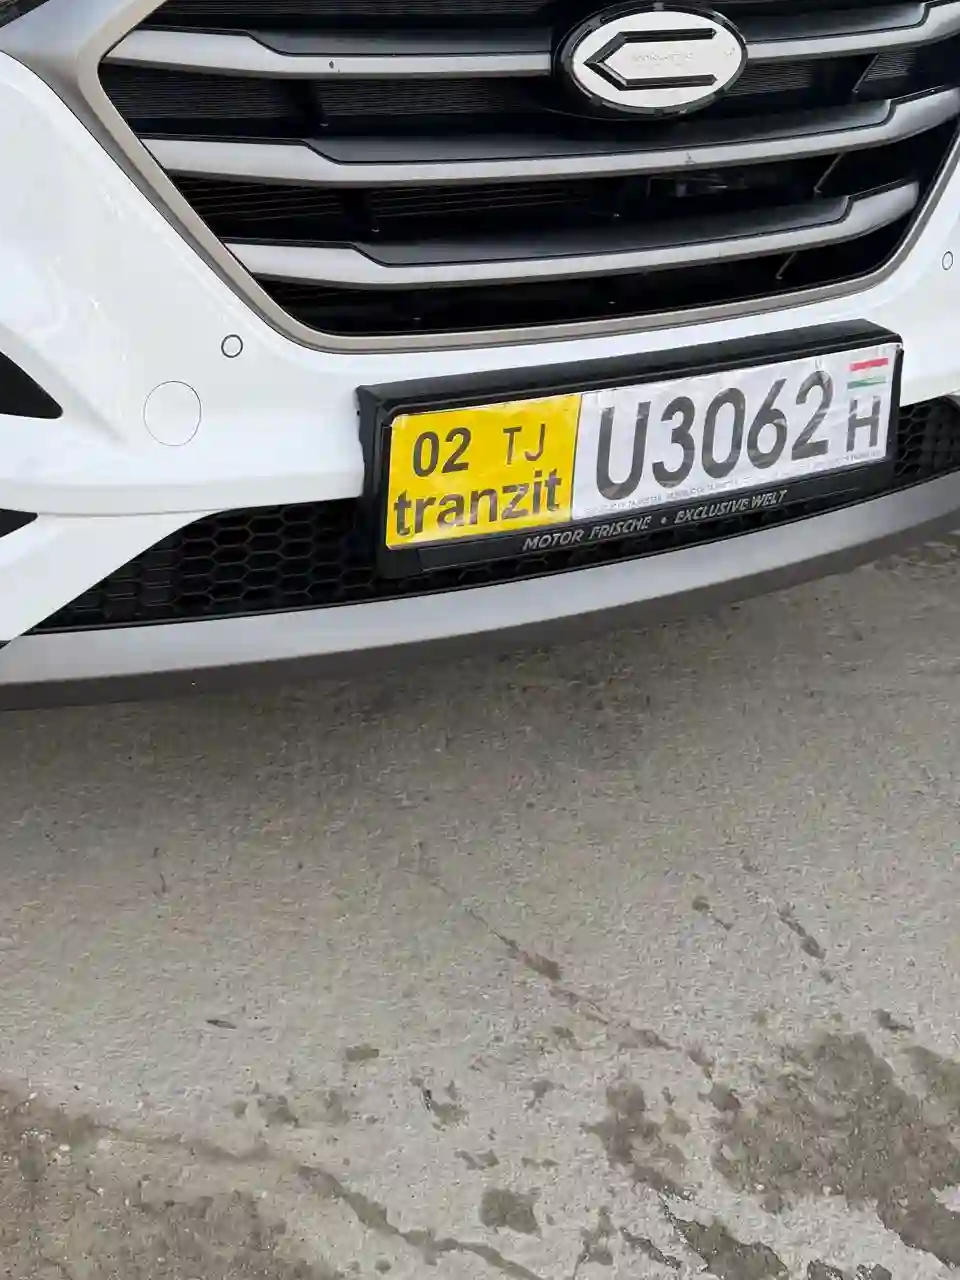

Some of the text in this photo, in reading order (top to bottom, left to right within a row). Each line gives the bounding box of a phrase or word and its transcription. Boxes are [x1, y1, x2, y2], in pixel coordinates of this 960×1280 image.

[413, 423, 546, 477] 02 TJ
[596, 370, 881, 501] U3062 H
[393, 468, 562, 537] tranzit
[521, 529, 585, 552] MOTOR
[674, 498, 750, 524] EXCLUSIVE
[751, 489, 788, 509] WELT
